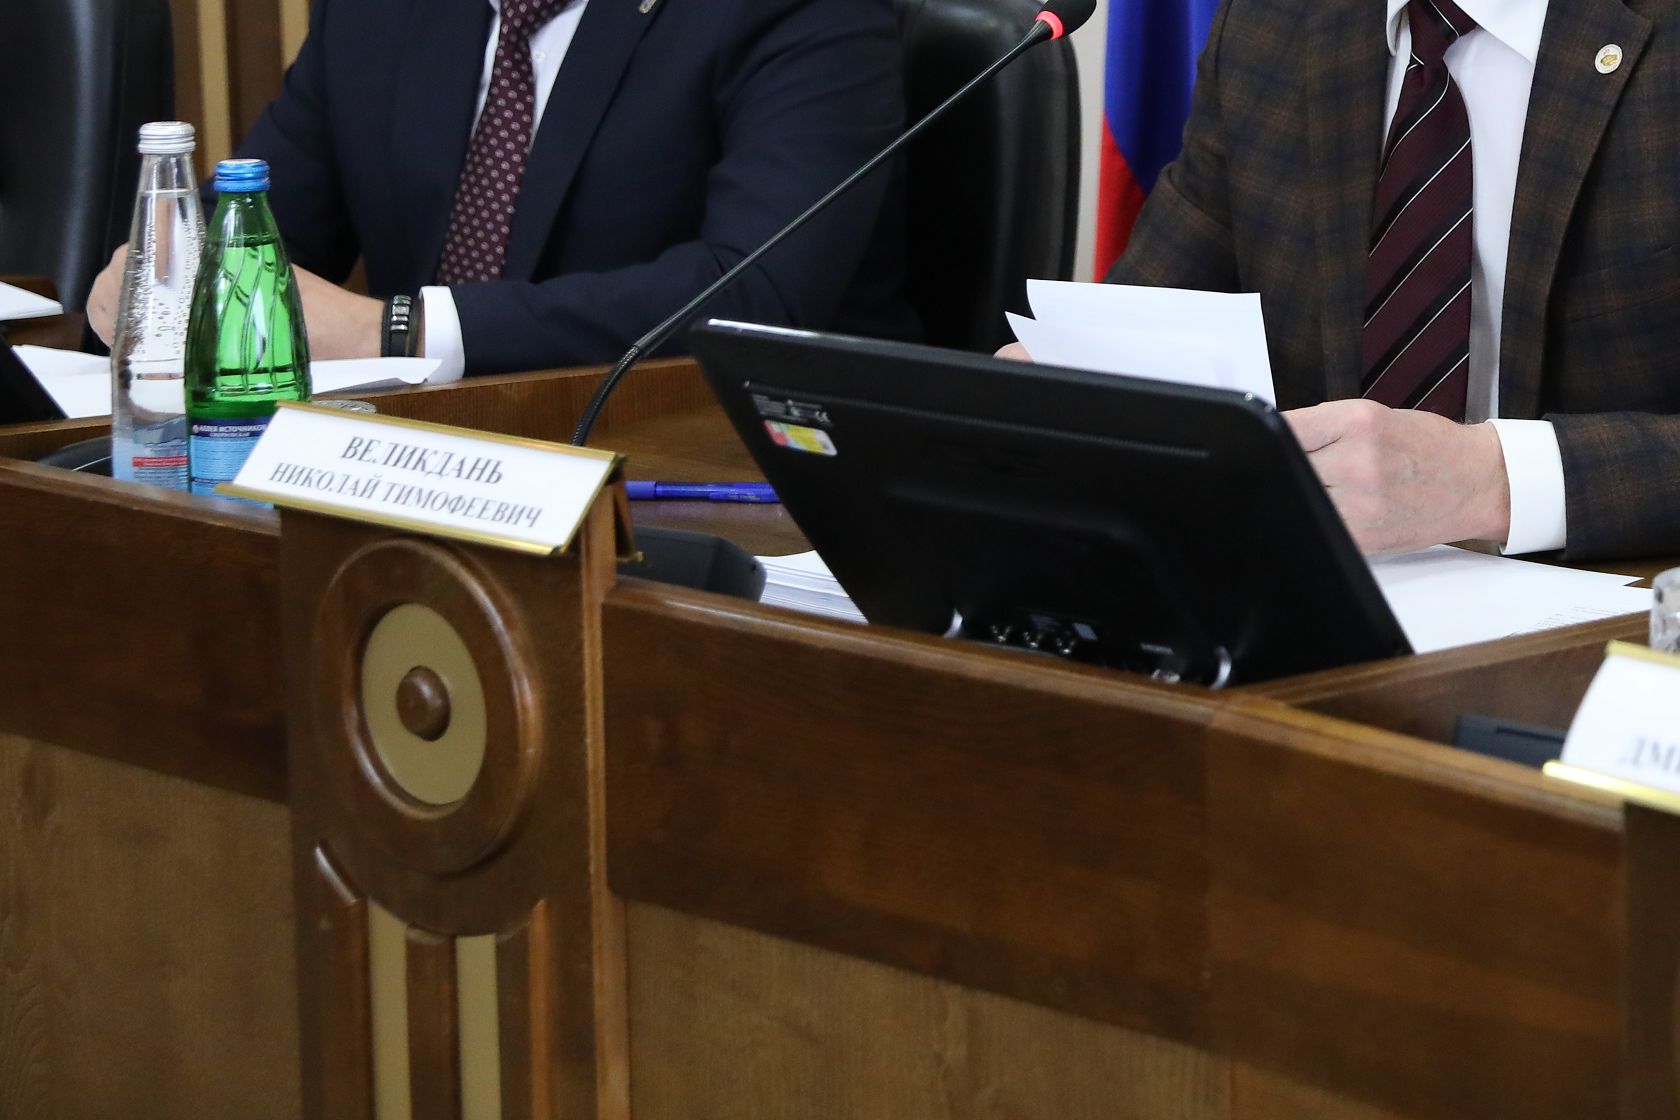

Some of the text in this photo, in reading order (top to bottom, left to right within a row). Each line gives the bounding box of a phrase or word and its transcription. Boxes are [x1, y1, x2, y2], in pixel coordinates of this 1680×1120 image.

[341, 436, 504, 484] ВЕЛИКДАНЬ
[270, 461, 544, 529] НИКОЛАЙ ТИМОФЕЕВИЧ
